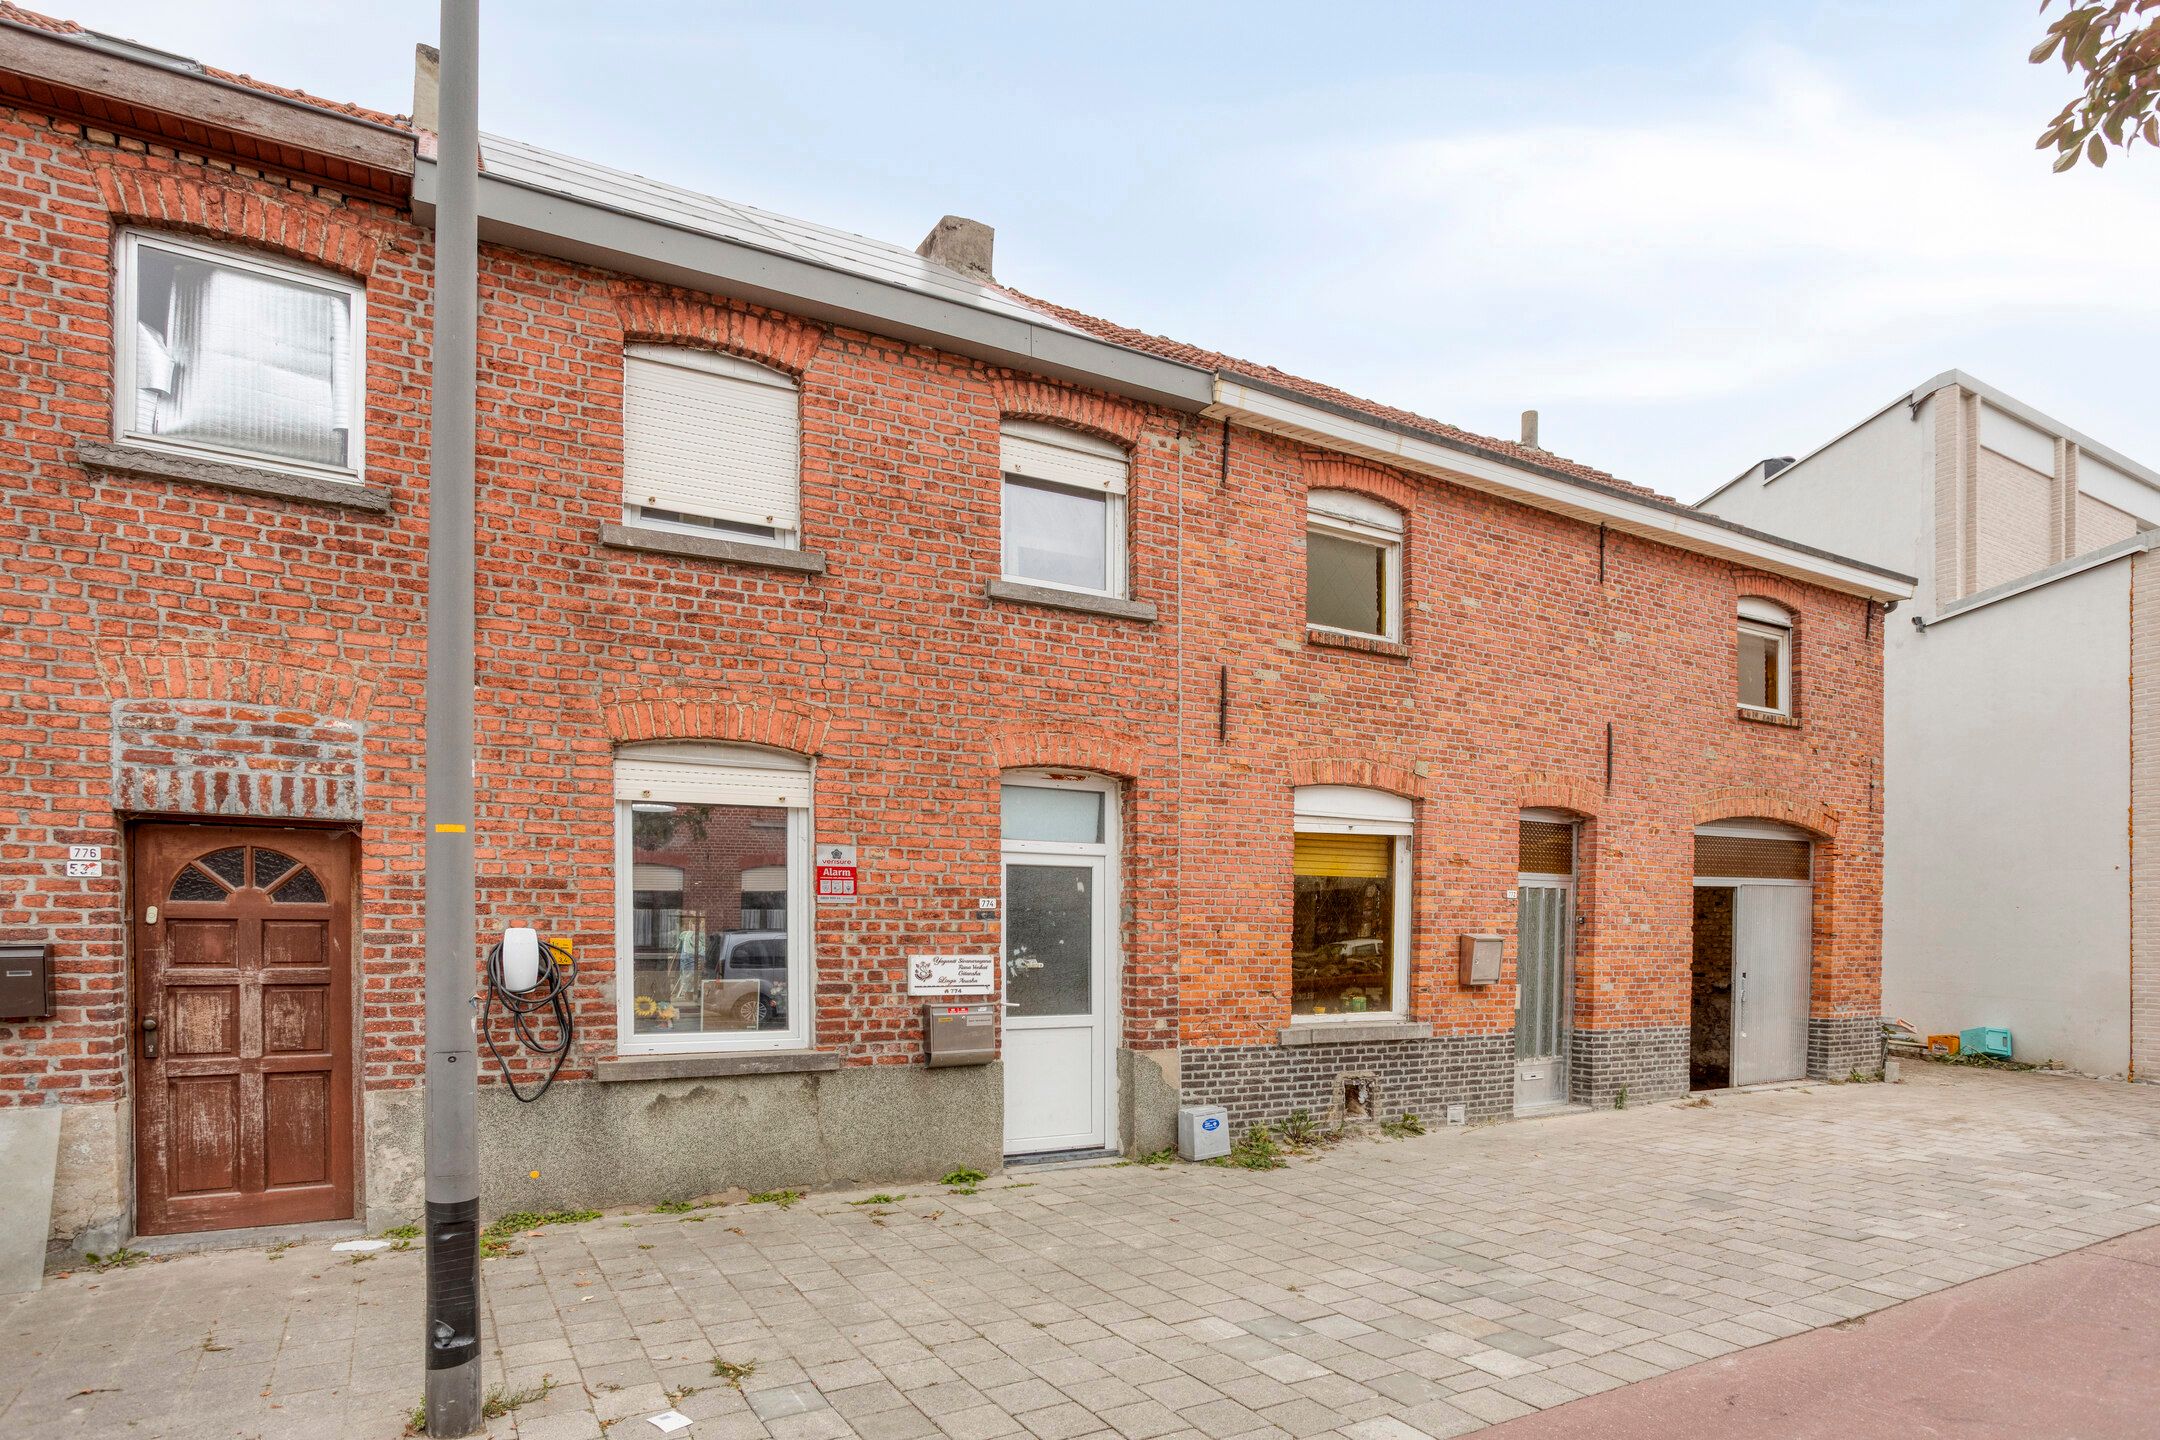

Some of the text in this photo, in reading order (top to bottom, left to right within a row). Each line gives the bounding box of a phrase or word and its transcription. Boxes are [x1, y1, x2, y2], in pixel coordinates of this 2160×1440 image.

[74, 847, 97, 858] 776
[823, 867, 851, 877] Alarm
[981, 899, 994, 907] 774
